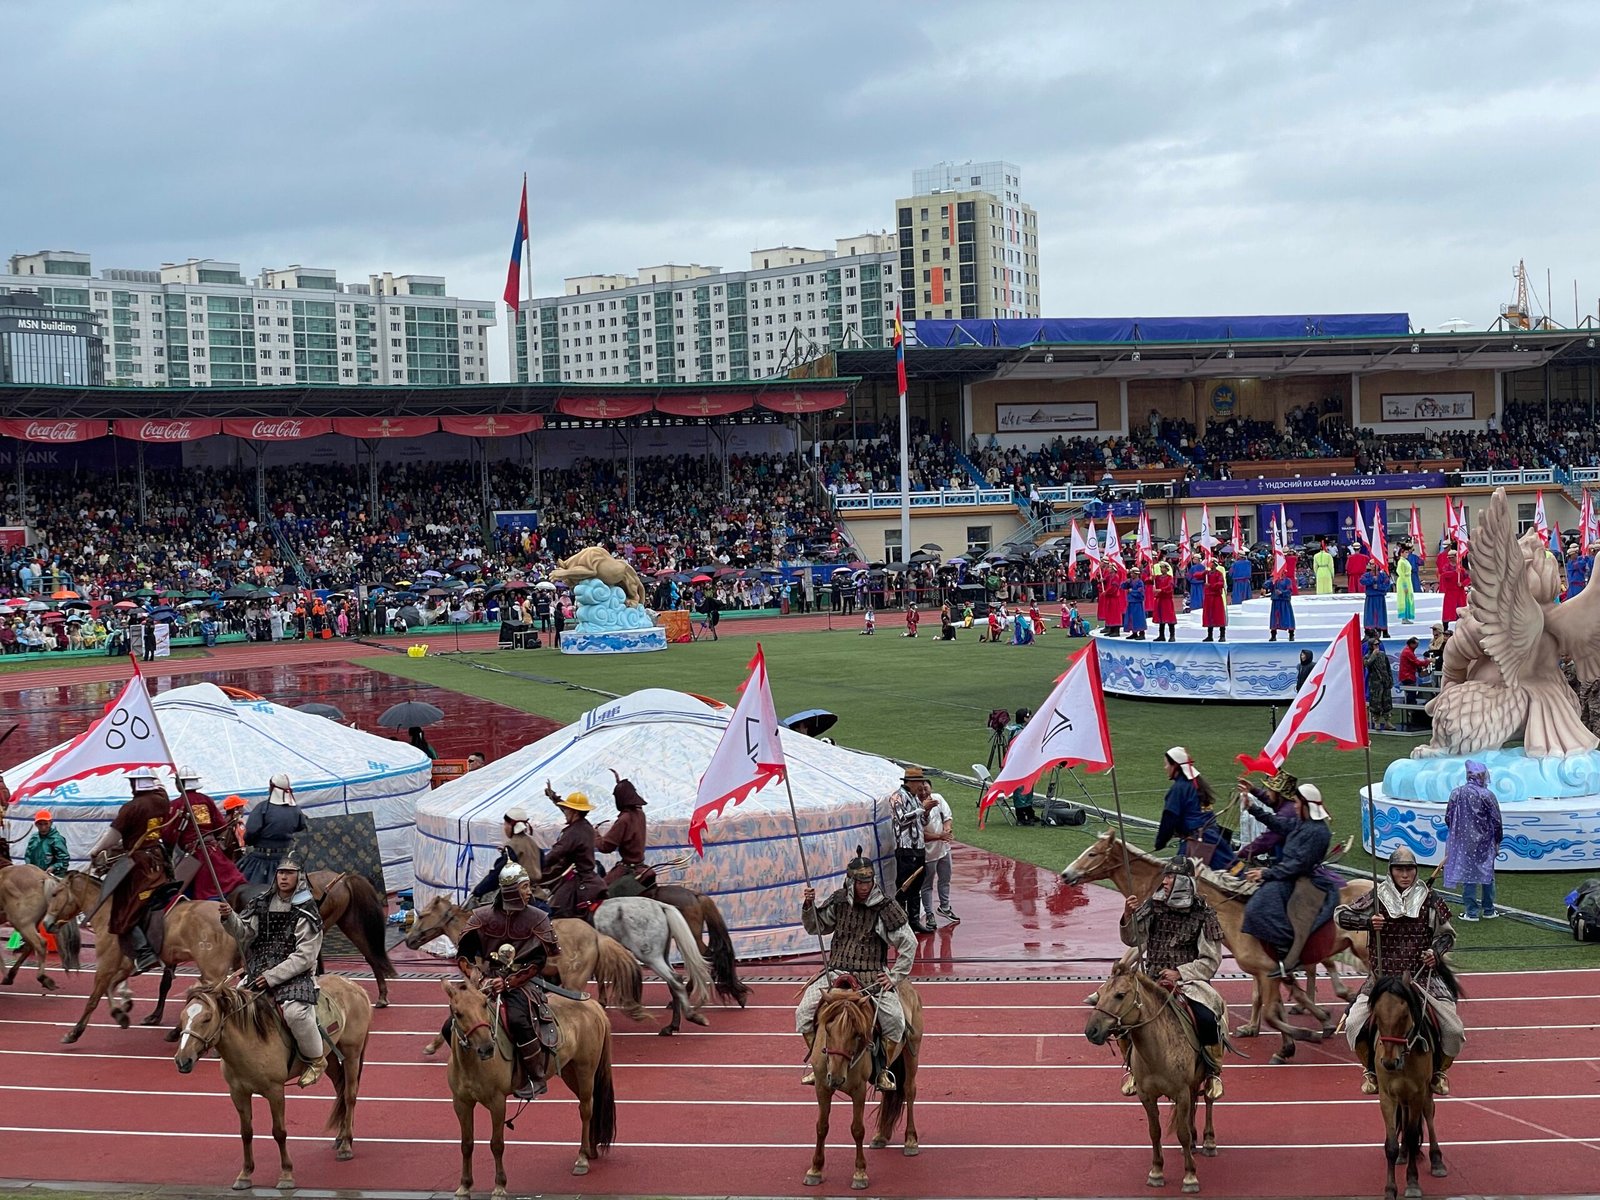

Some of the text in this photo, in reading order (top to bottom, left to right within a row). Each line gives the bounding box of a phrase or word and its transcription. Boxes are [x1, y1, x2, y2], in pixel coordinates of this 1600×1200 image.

[18, 319, 77, 334] MSN building
[26, 422, 77, 440] Coca-Cola
[140, 421, 191, 440] Coca-Cola
[252, 421, 303, 438] Coca-Cola
[1265, 478, 1375, 490] ҮНДЭСНИЙ ИХ БАЯР НААДАМ 2023
